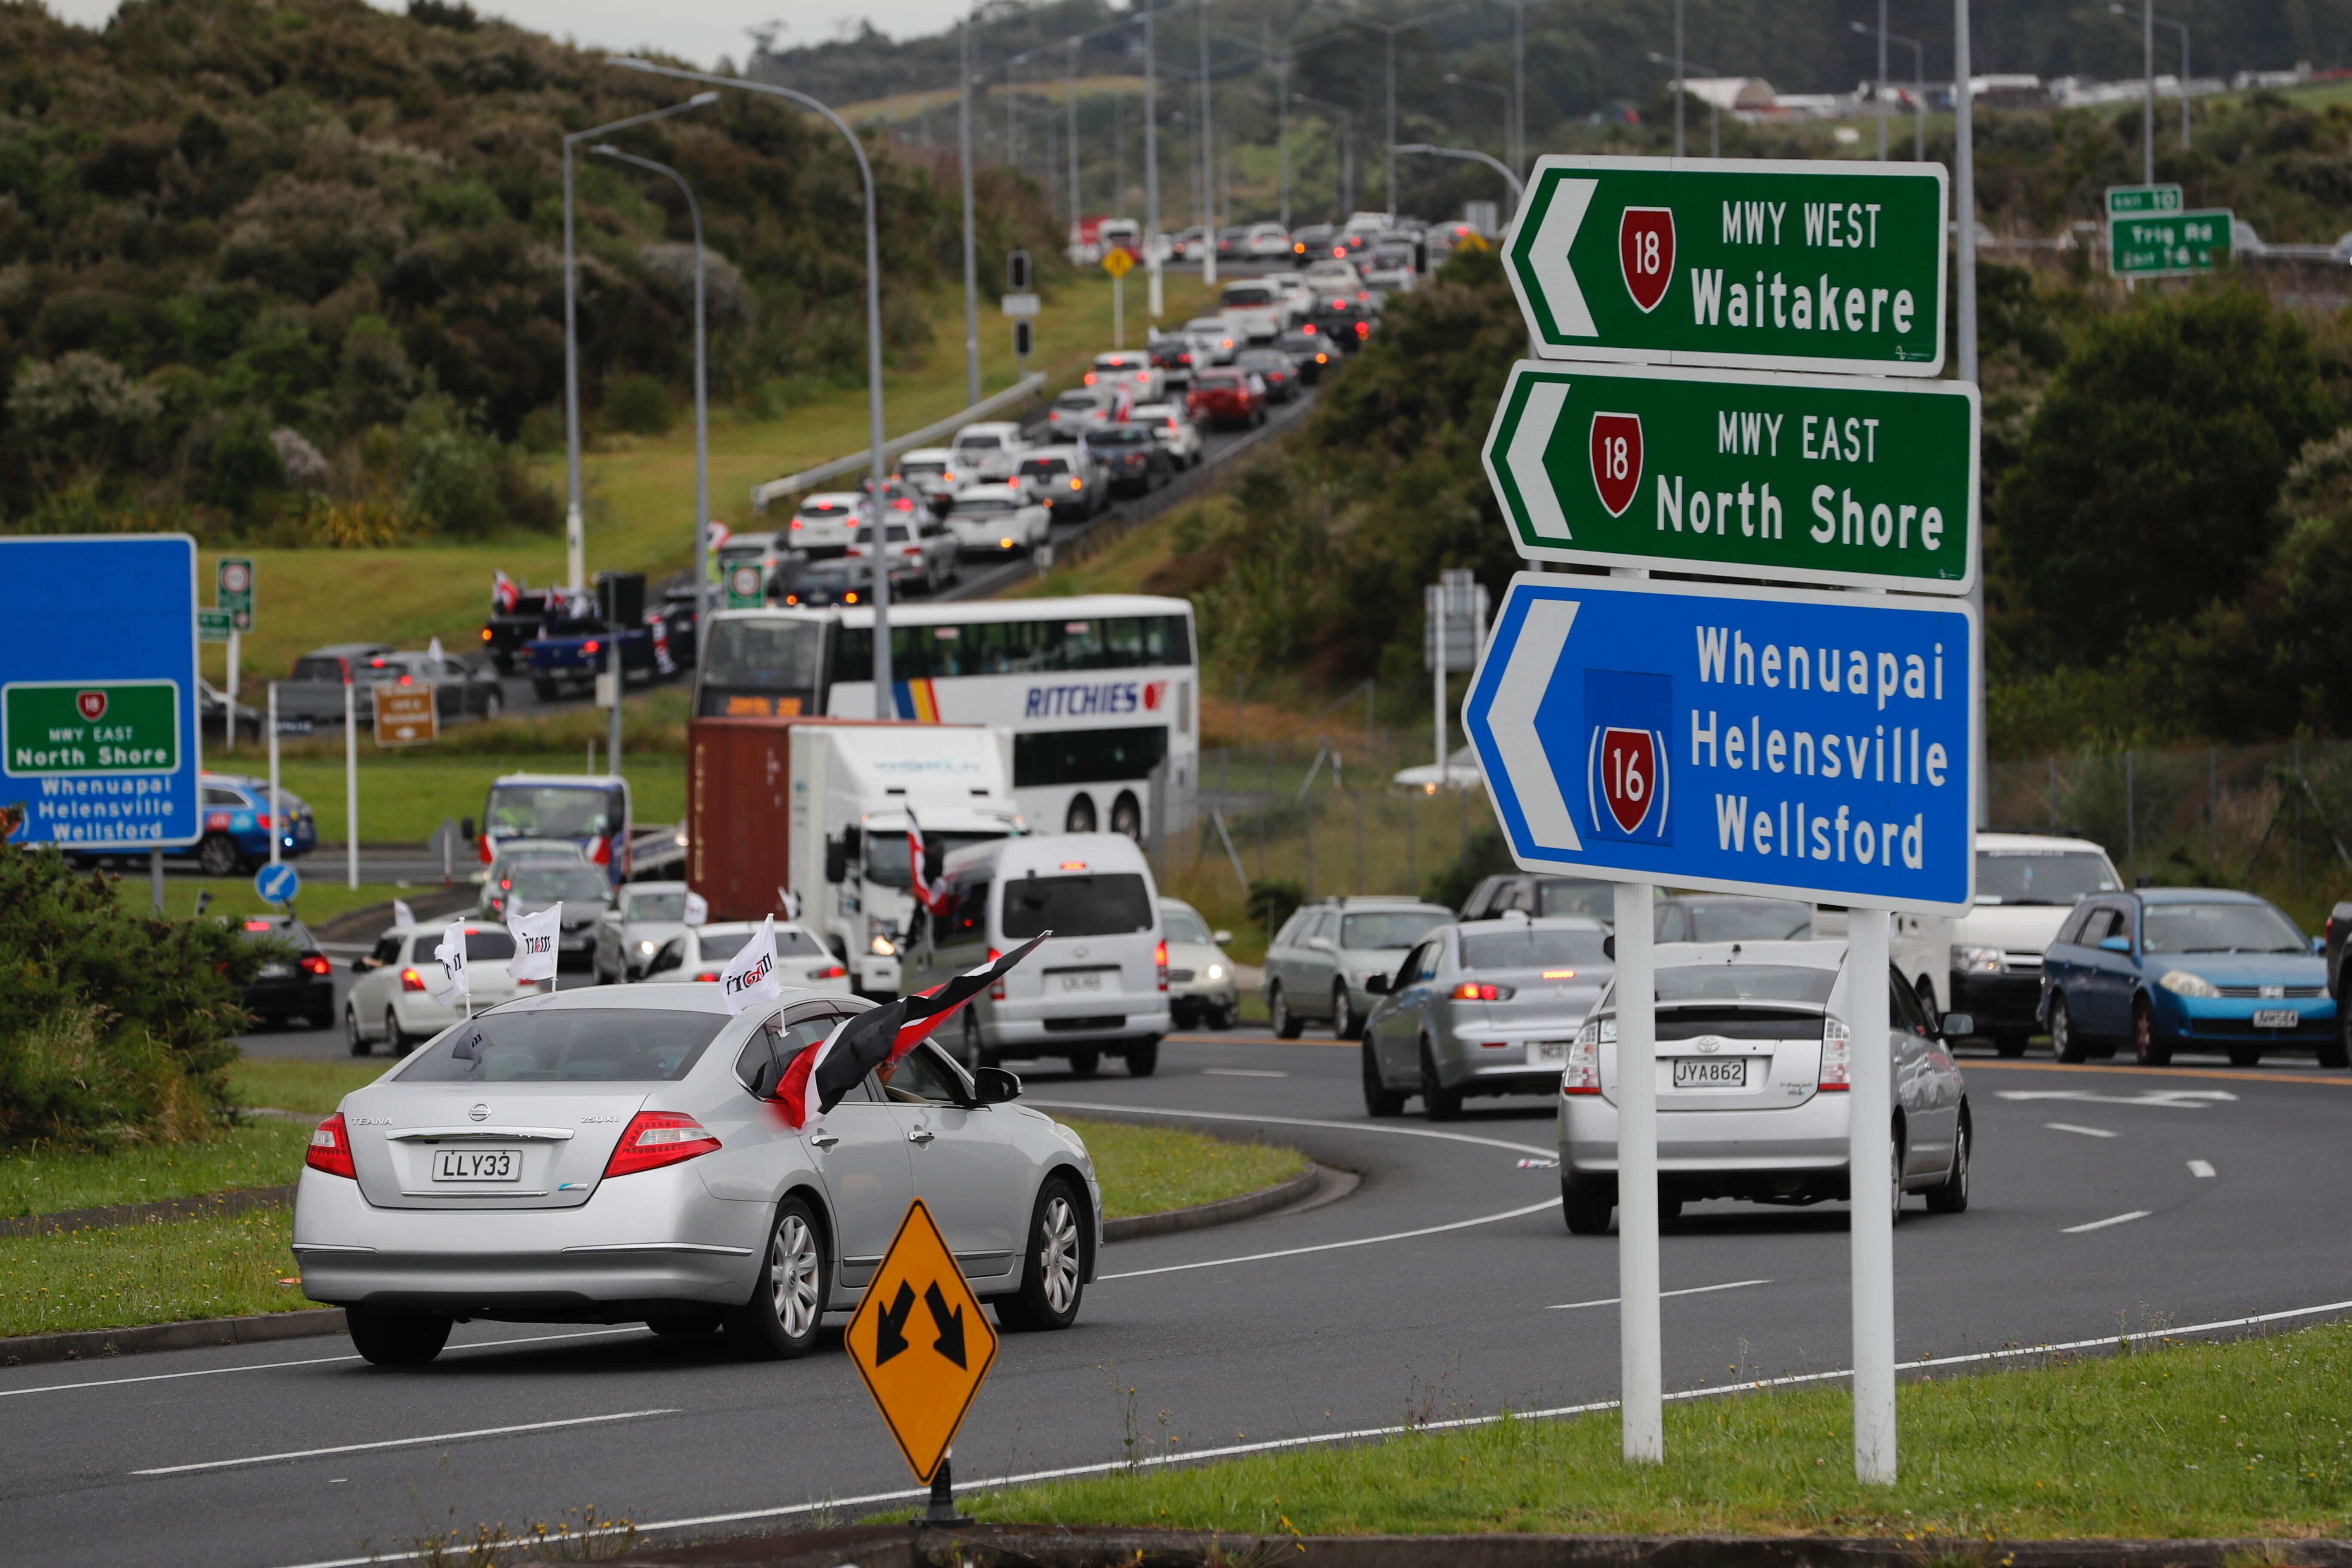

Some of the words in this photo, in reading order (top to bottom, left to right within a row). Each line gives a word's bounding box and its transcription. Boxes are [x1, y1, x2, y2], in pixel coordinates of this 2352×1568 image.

[1723, 201, 1786, 245] MWY
[1805, 203, 1880, 248] WEST
[2132, 225, 2174, 247] Trig
[2185, 223, 2212, 242] Rd
[1635, 231, 1660, 274] 18
[1691, 268, 1914, 333] Waitakere
[1719, 411, 1783, 456] MWY
[1804, 416, 1879, 462] EAST
[1605, 437, 1628, 480] 18
[1658, 475, 1782, 539] North
[1810, 485, 1943, 550] Shore
[1697, 626, 1942, 710] Whenuapai
[1025, 683, 1137, 718] RITCHIES
[49, 728, 83, 742] MWY
[93, 726, 133, 741] EAST
[1692, 710, 1947, 786] Helensville
[16, 748, 85, 766] North
[98, 746, 166, 765] Shore
[1614, 749, 1644, 801] 16
[42, 776, 171, 798] Whenuapai
[39, 796, 173, 818] Helensville
[52, 822, 163, 842] Wellsford
[1716, 794, 1922, 869] Wellsford
[1677, 1065, 1742, 1081] JYA862
[352, 1117, 392, 1125] TEANA
[444, 1156, 509, 1176] LLY33
